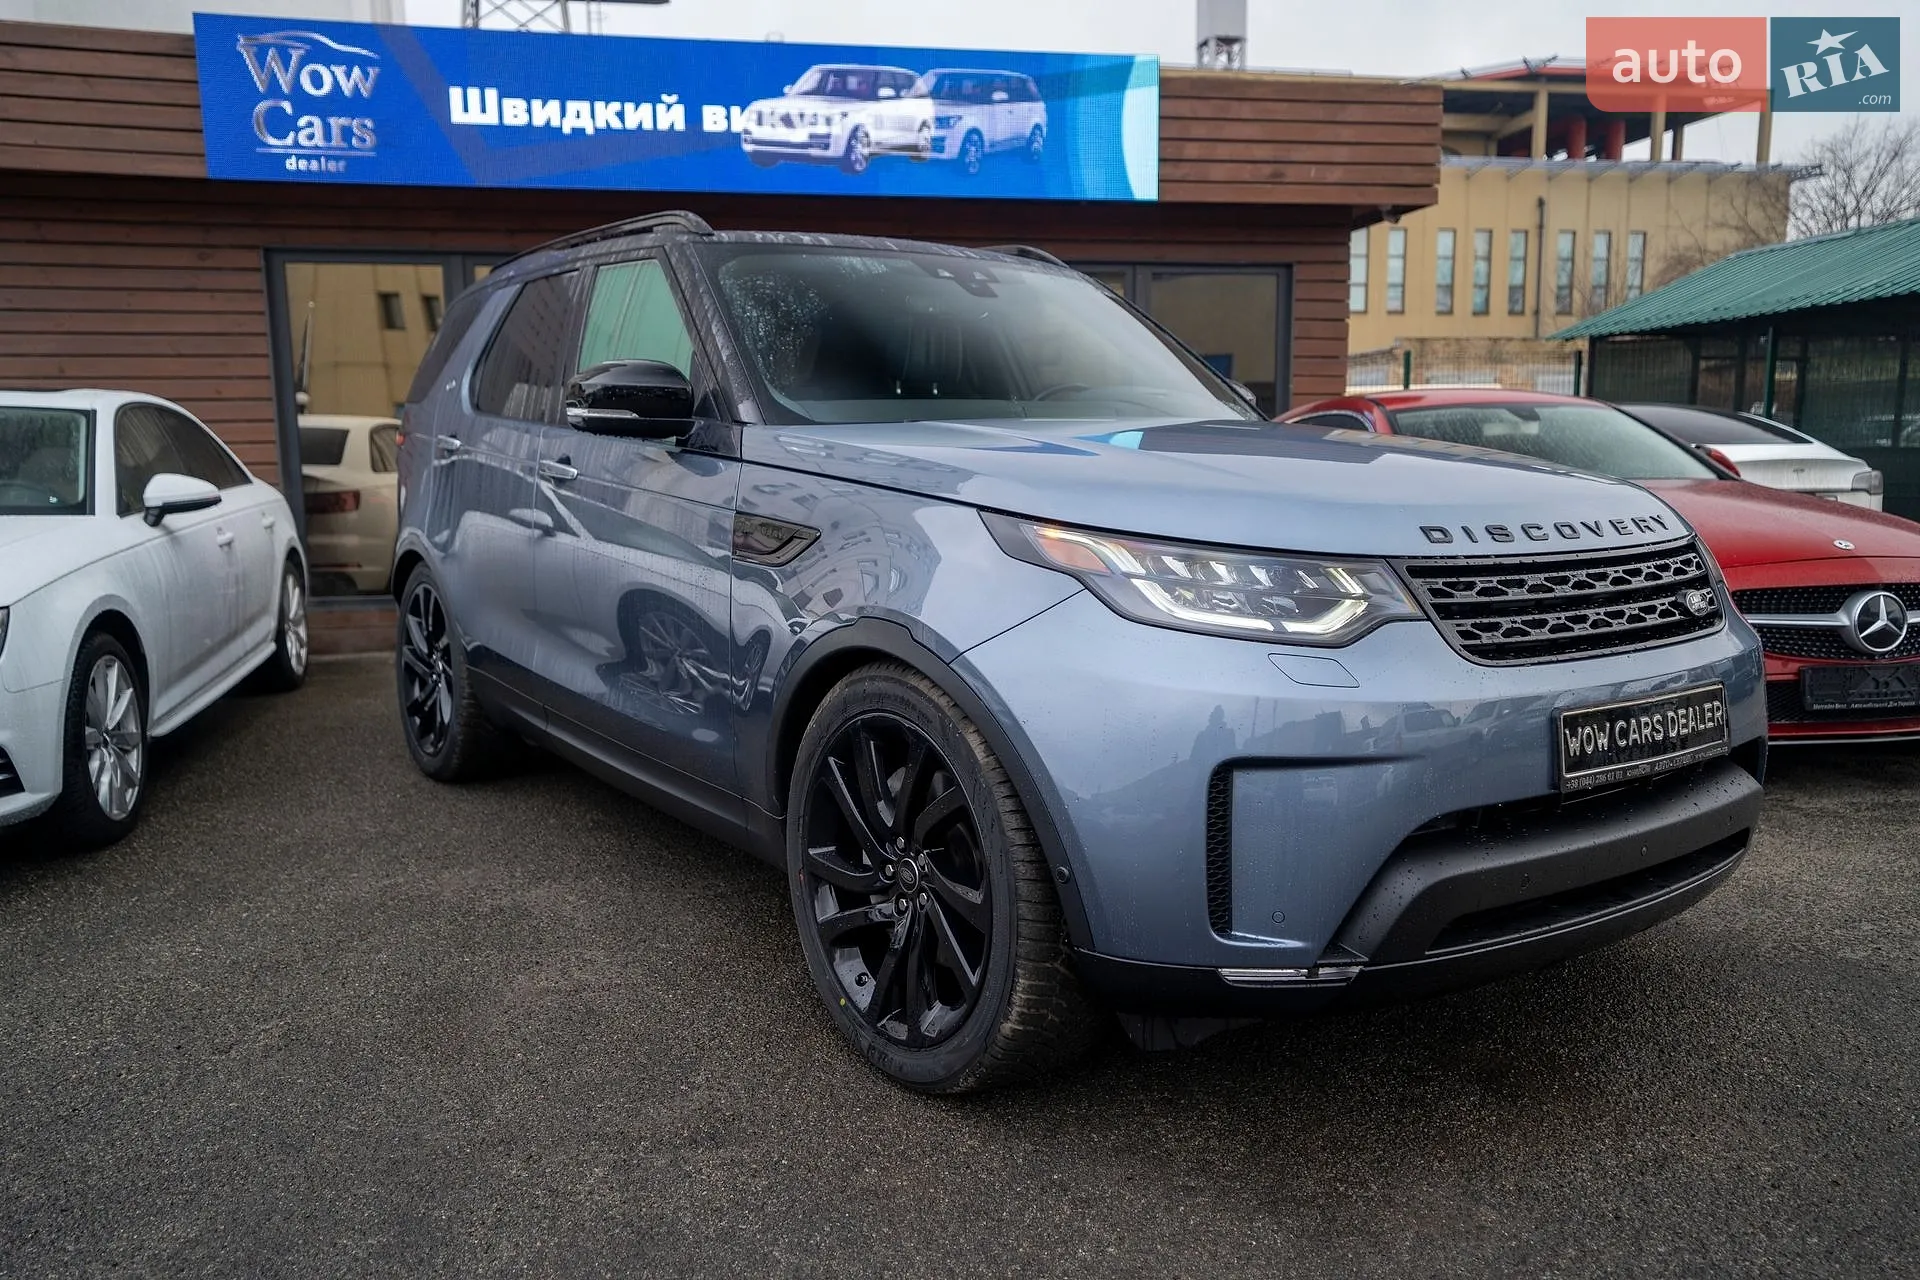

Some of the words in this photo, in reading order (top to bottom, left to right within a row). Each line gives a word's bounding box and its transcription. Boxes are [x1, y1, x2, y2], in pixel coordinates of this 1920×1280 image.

[238, 44, 381, 97] Wow
[253, 99, 377, 149] Cars
[449, 86, 686, 135] Швидкий
[285, 154, 346, 171] dealer
[1419, 514, 1669, 544] DISCOVERY
[1565, 722, 1611, 757] WOW
[1615, 713, 1664, 747] CARS
[1667, 700, 1723, 738] DEALER
